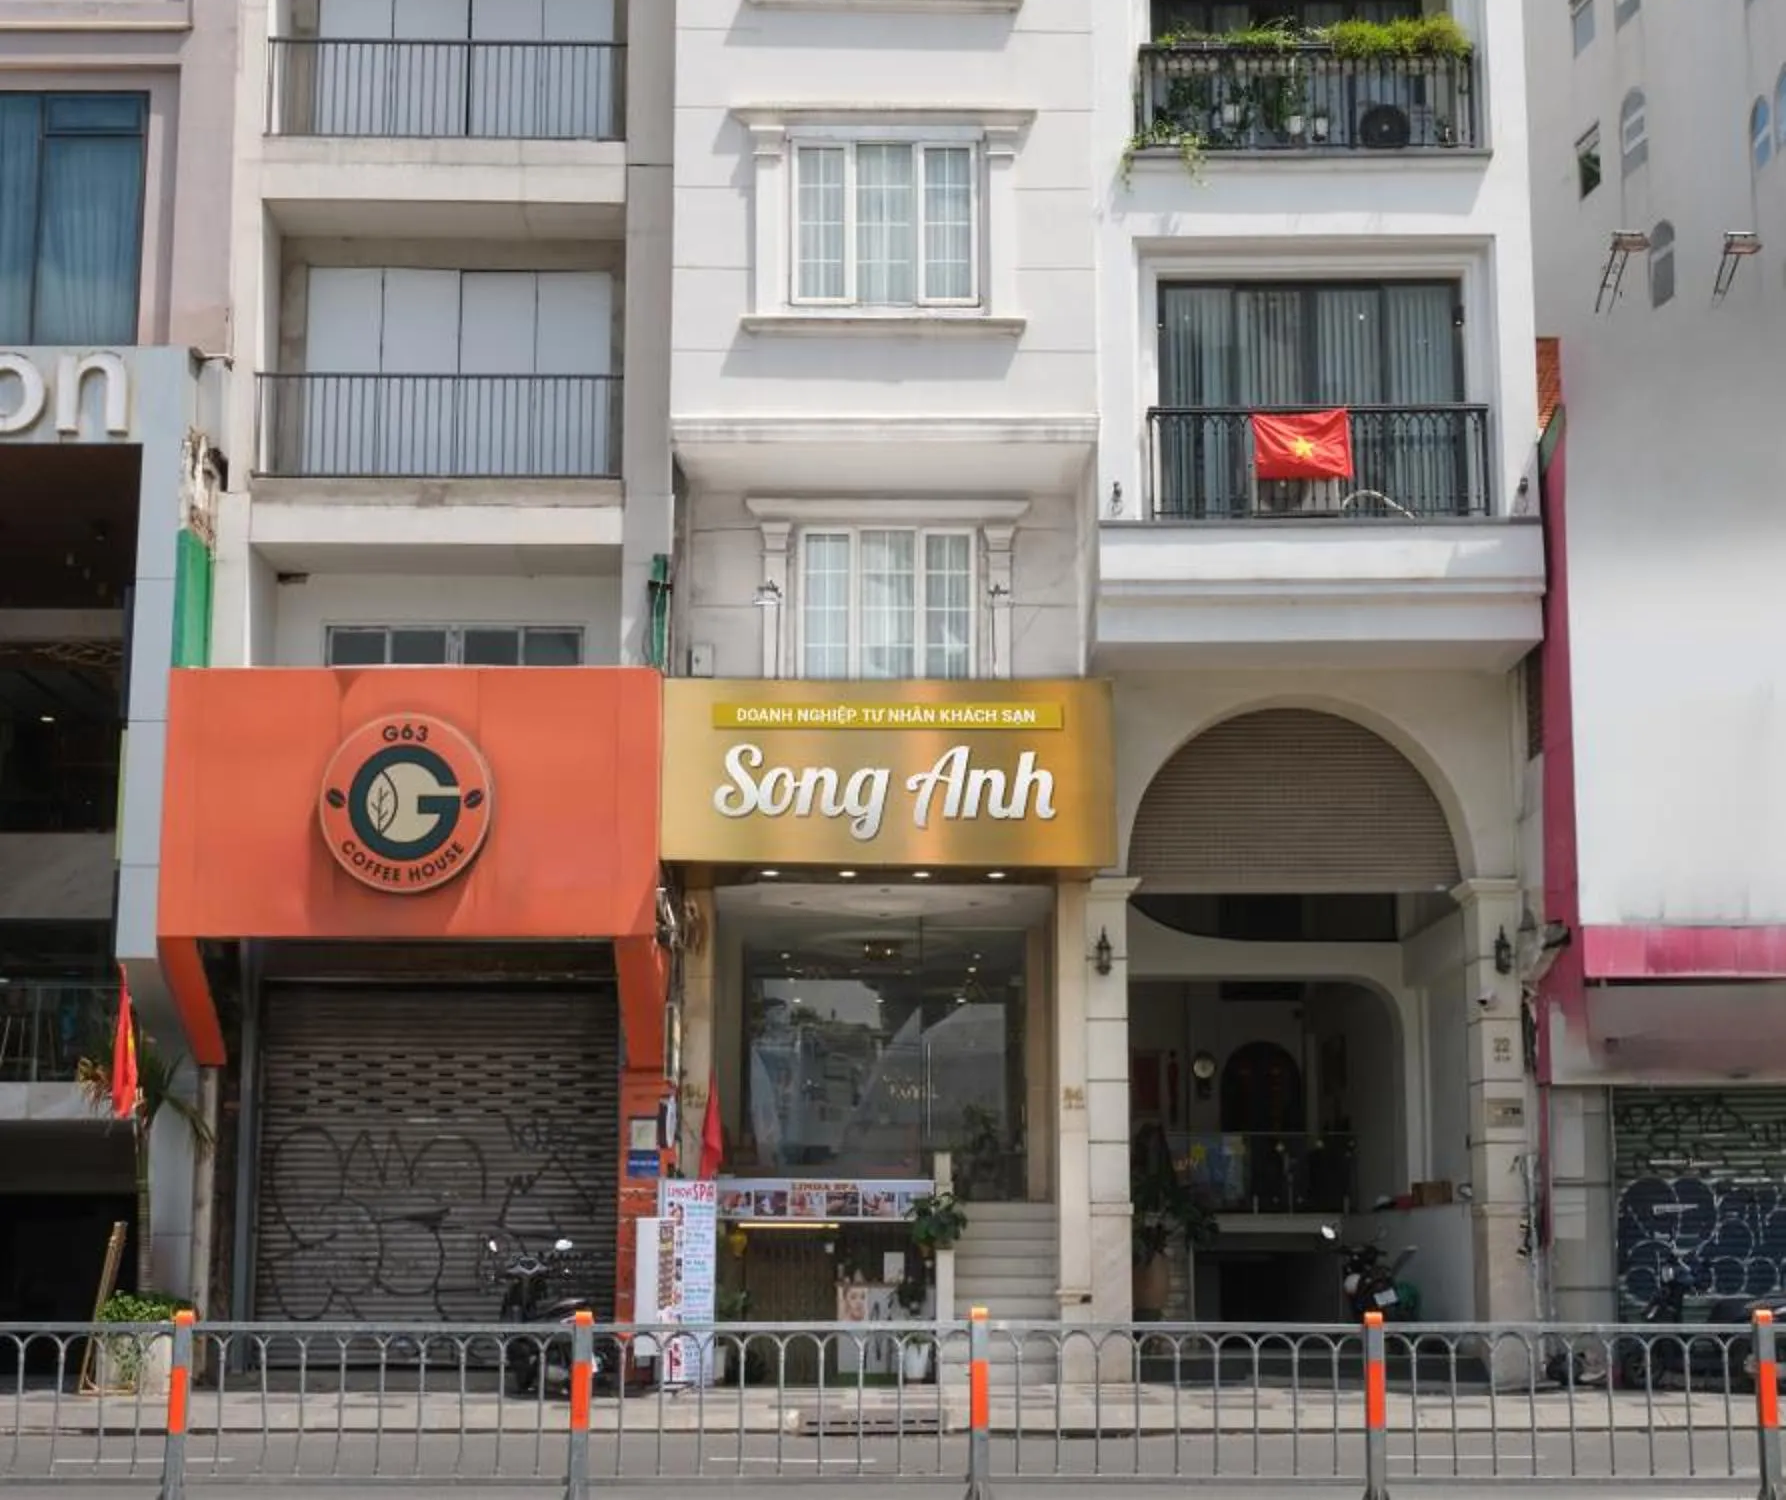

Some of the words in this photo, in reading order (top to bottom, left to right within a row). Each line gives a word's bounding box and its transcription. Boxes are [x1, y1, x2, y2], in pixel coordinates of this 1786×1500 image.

[736, 707, 793, 723] DOANH
[797, 705, 857, 726] NGHIỆP
[861, 706, 887, 723] TƯ
[888, 705, 935, 723] NHÂN
[939, 704, 998, 724] KHÁCH
[1002, 707, 1037, 727] SẠN
[382, 724, 429, 743] G63
[713, 743, 890, 841] Song
[906, 745, 1057, 830] Anh
[341, 840, 401, 882] COFFEE
[407, 842, 465, 882] HOUSE
